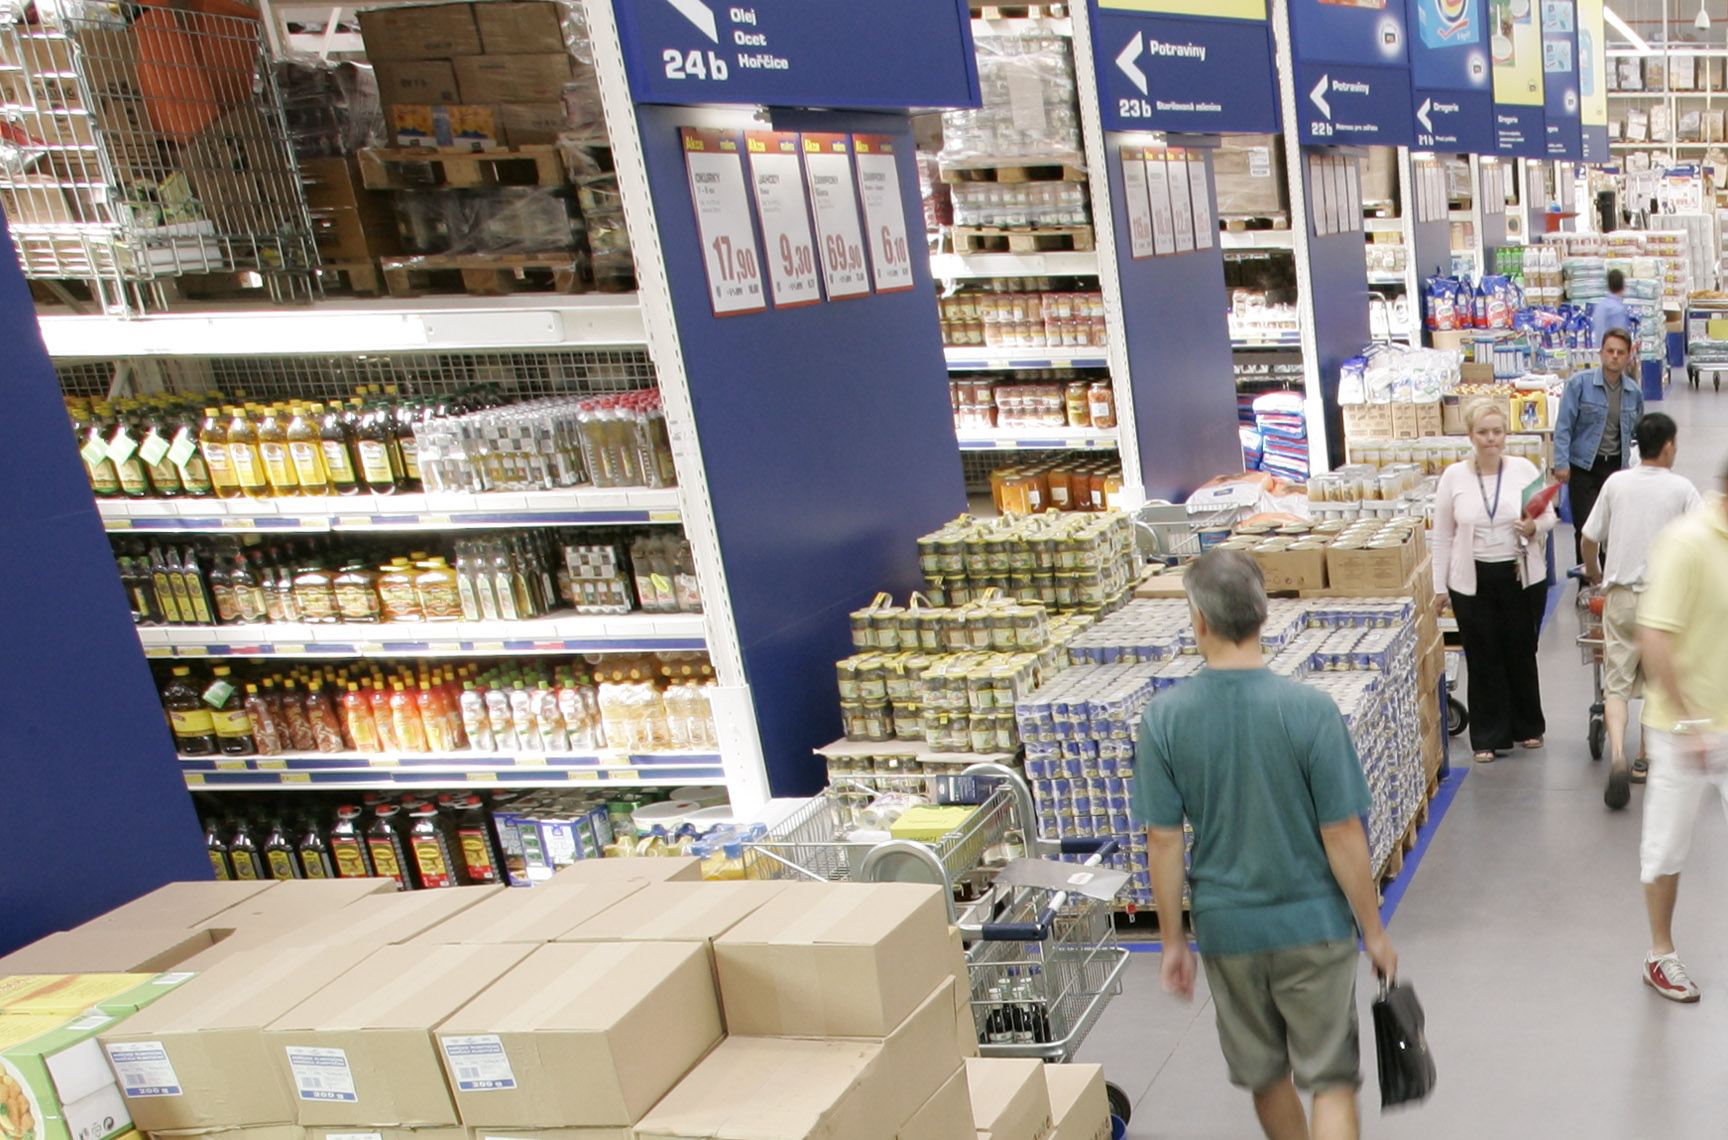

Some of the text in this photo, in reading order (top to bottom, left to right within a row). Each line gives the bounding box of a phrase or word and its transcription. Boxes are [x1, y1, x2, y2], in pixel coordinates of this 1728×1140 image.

[730, 7, 757, 26] Olej
[734, 30, 767, 46] Ocet
[738, 52, 789, 70] Hořčice
[1150, 40, 1206, 61] Potraviny
[1332, 79, 1370, 96] Potraviny
[826, 234, 862, 273] 69,90
[881, 225, 907, 267] 6,10
[713, 235, 757, 284] 17,90
[780, 233, 813, 281] 9,30
